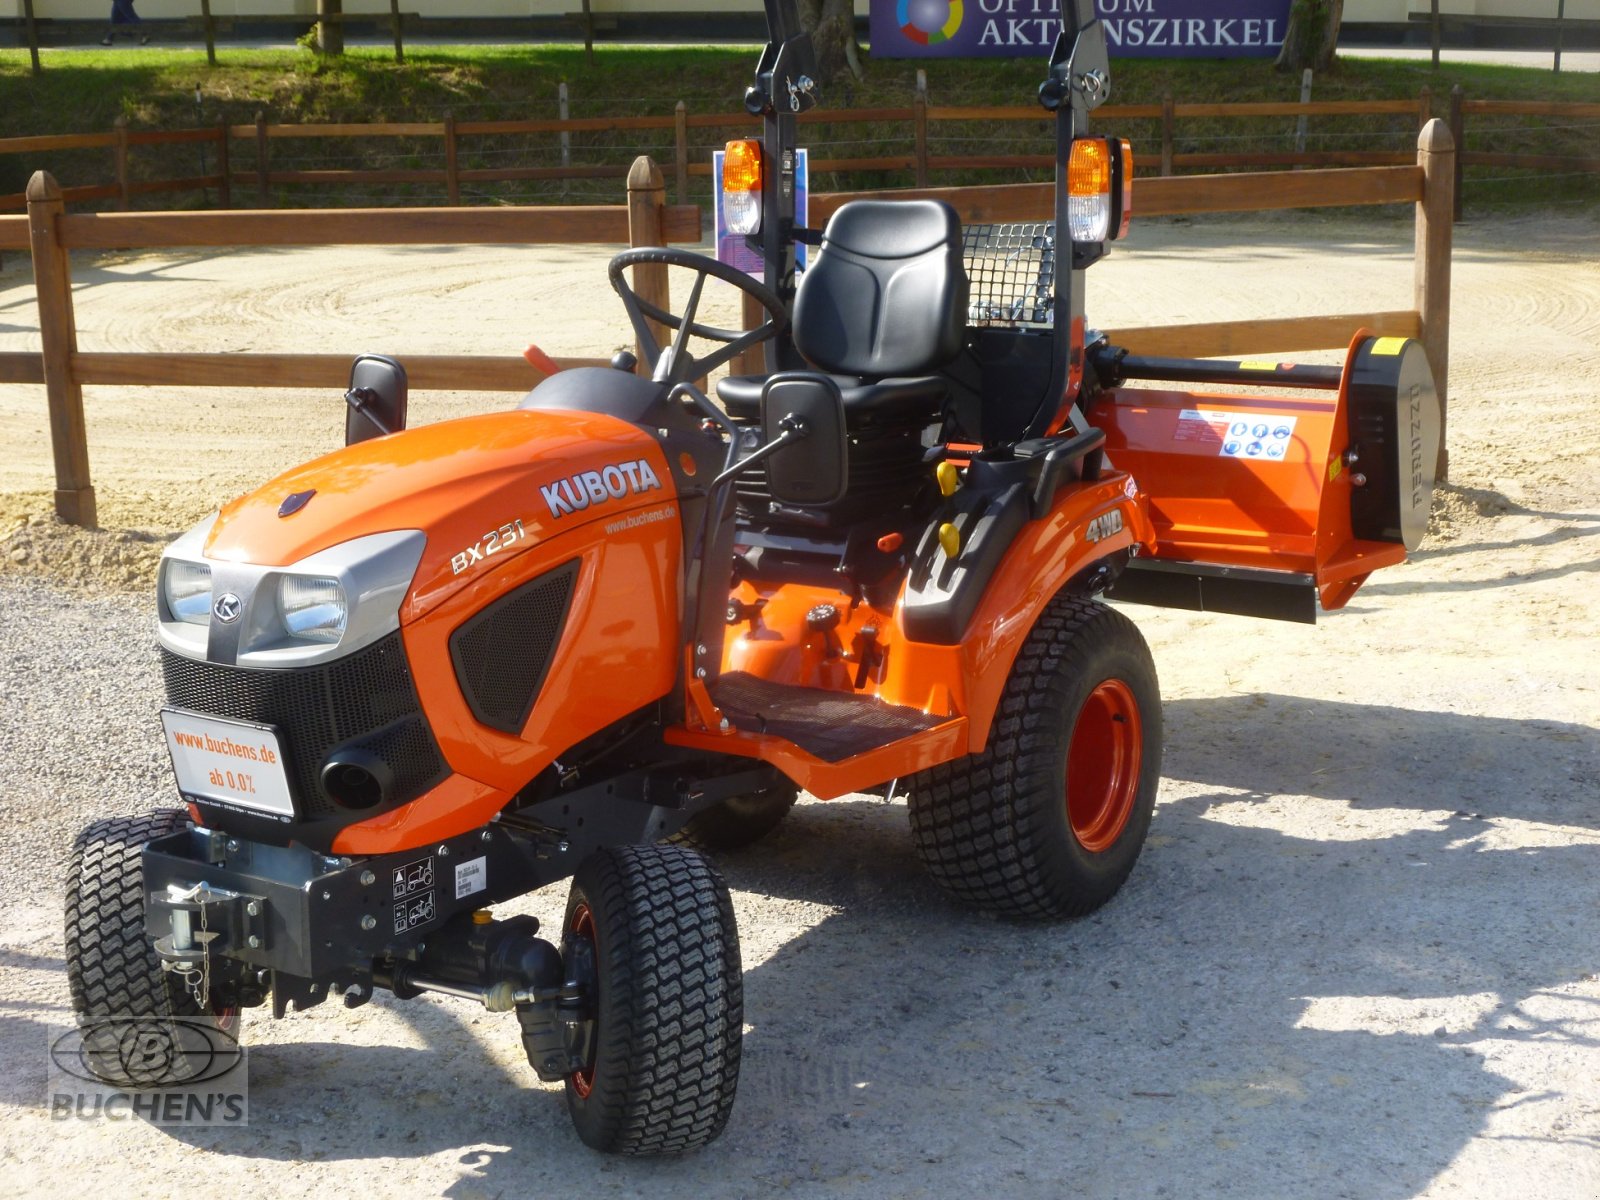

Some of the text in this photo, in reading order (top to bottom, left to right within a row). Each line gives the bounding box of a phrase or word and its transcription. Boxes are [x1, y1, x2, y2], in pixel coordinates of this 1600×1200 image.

[978, 18, 1285, 46] AKTNSZIRKEL
[539, 459, 662, 519] KUBOTA
[604, 506, 676, 534] www.buchens.de
[1086, 508, 1123, 543] 4WD
[173, 731, 277, 764] www.buchens.de
[209, 768, 225, 787] ab
